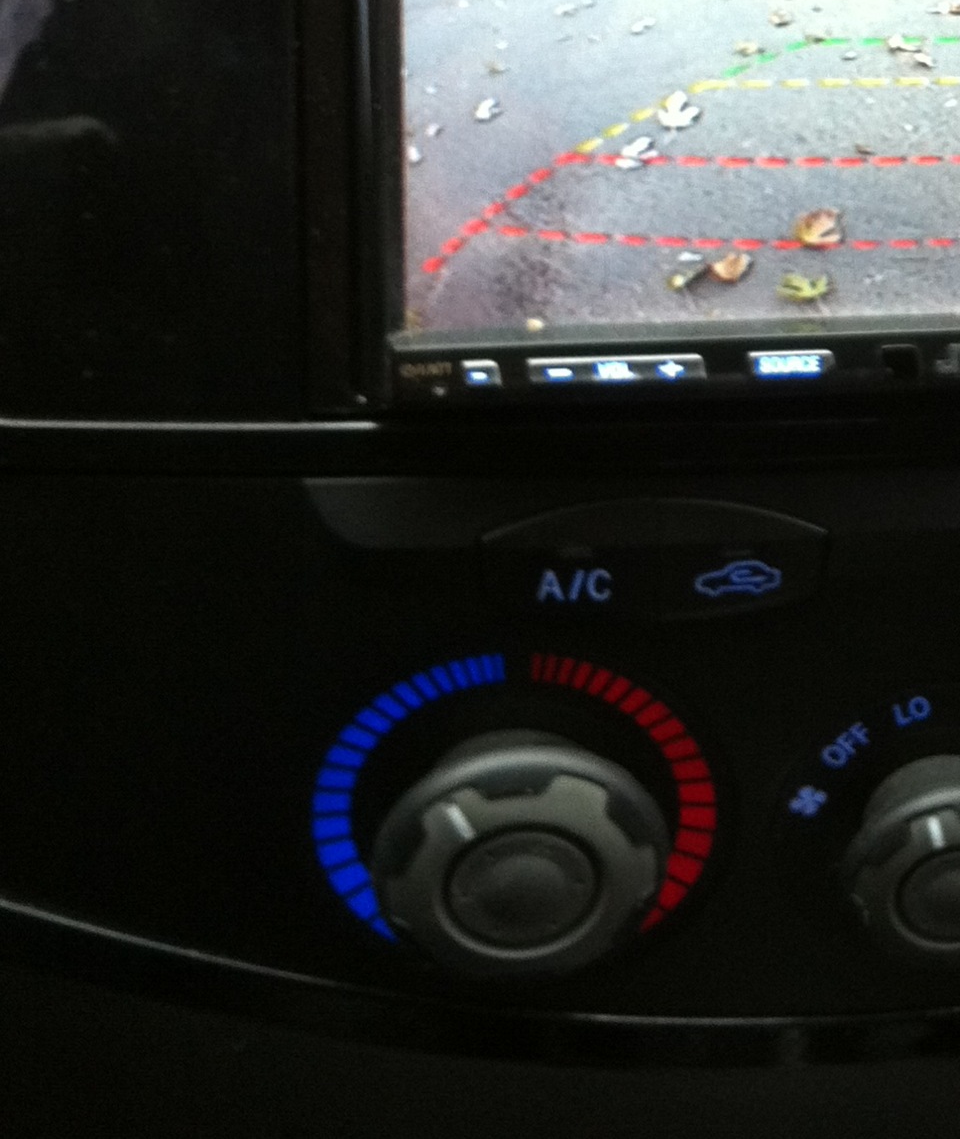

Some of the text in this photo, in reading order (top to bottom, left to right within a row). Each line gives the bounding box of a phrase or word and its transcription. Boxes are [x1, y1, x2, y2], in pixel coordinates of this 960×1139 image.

[759, 355, 821, 374] SOURCE
[536, 568, 613, 602] A/C
[892, 696, 931, 727] LO
[820, 721, 870, 769] OFF
